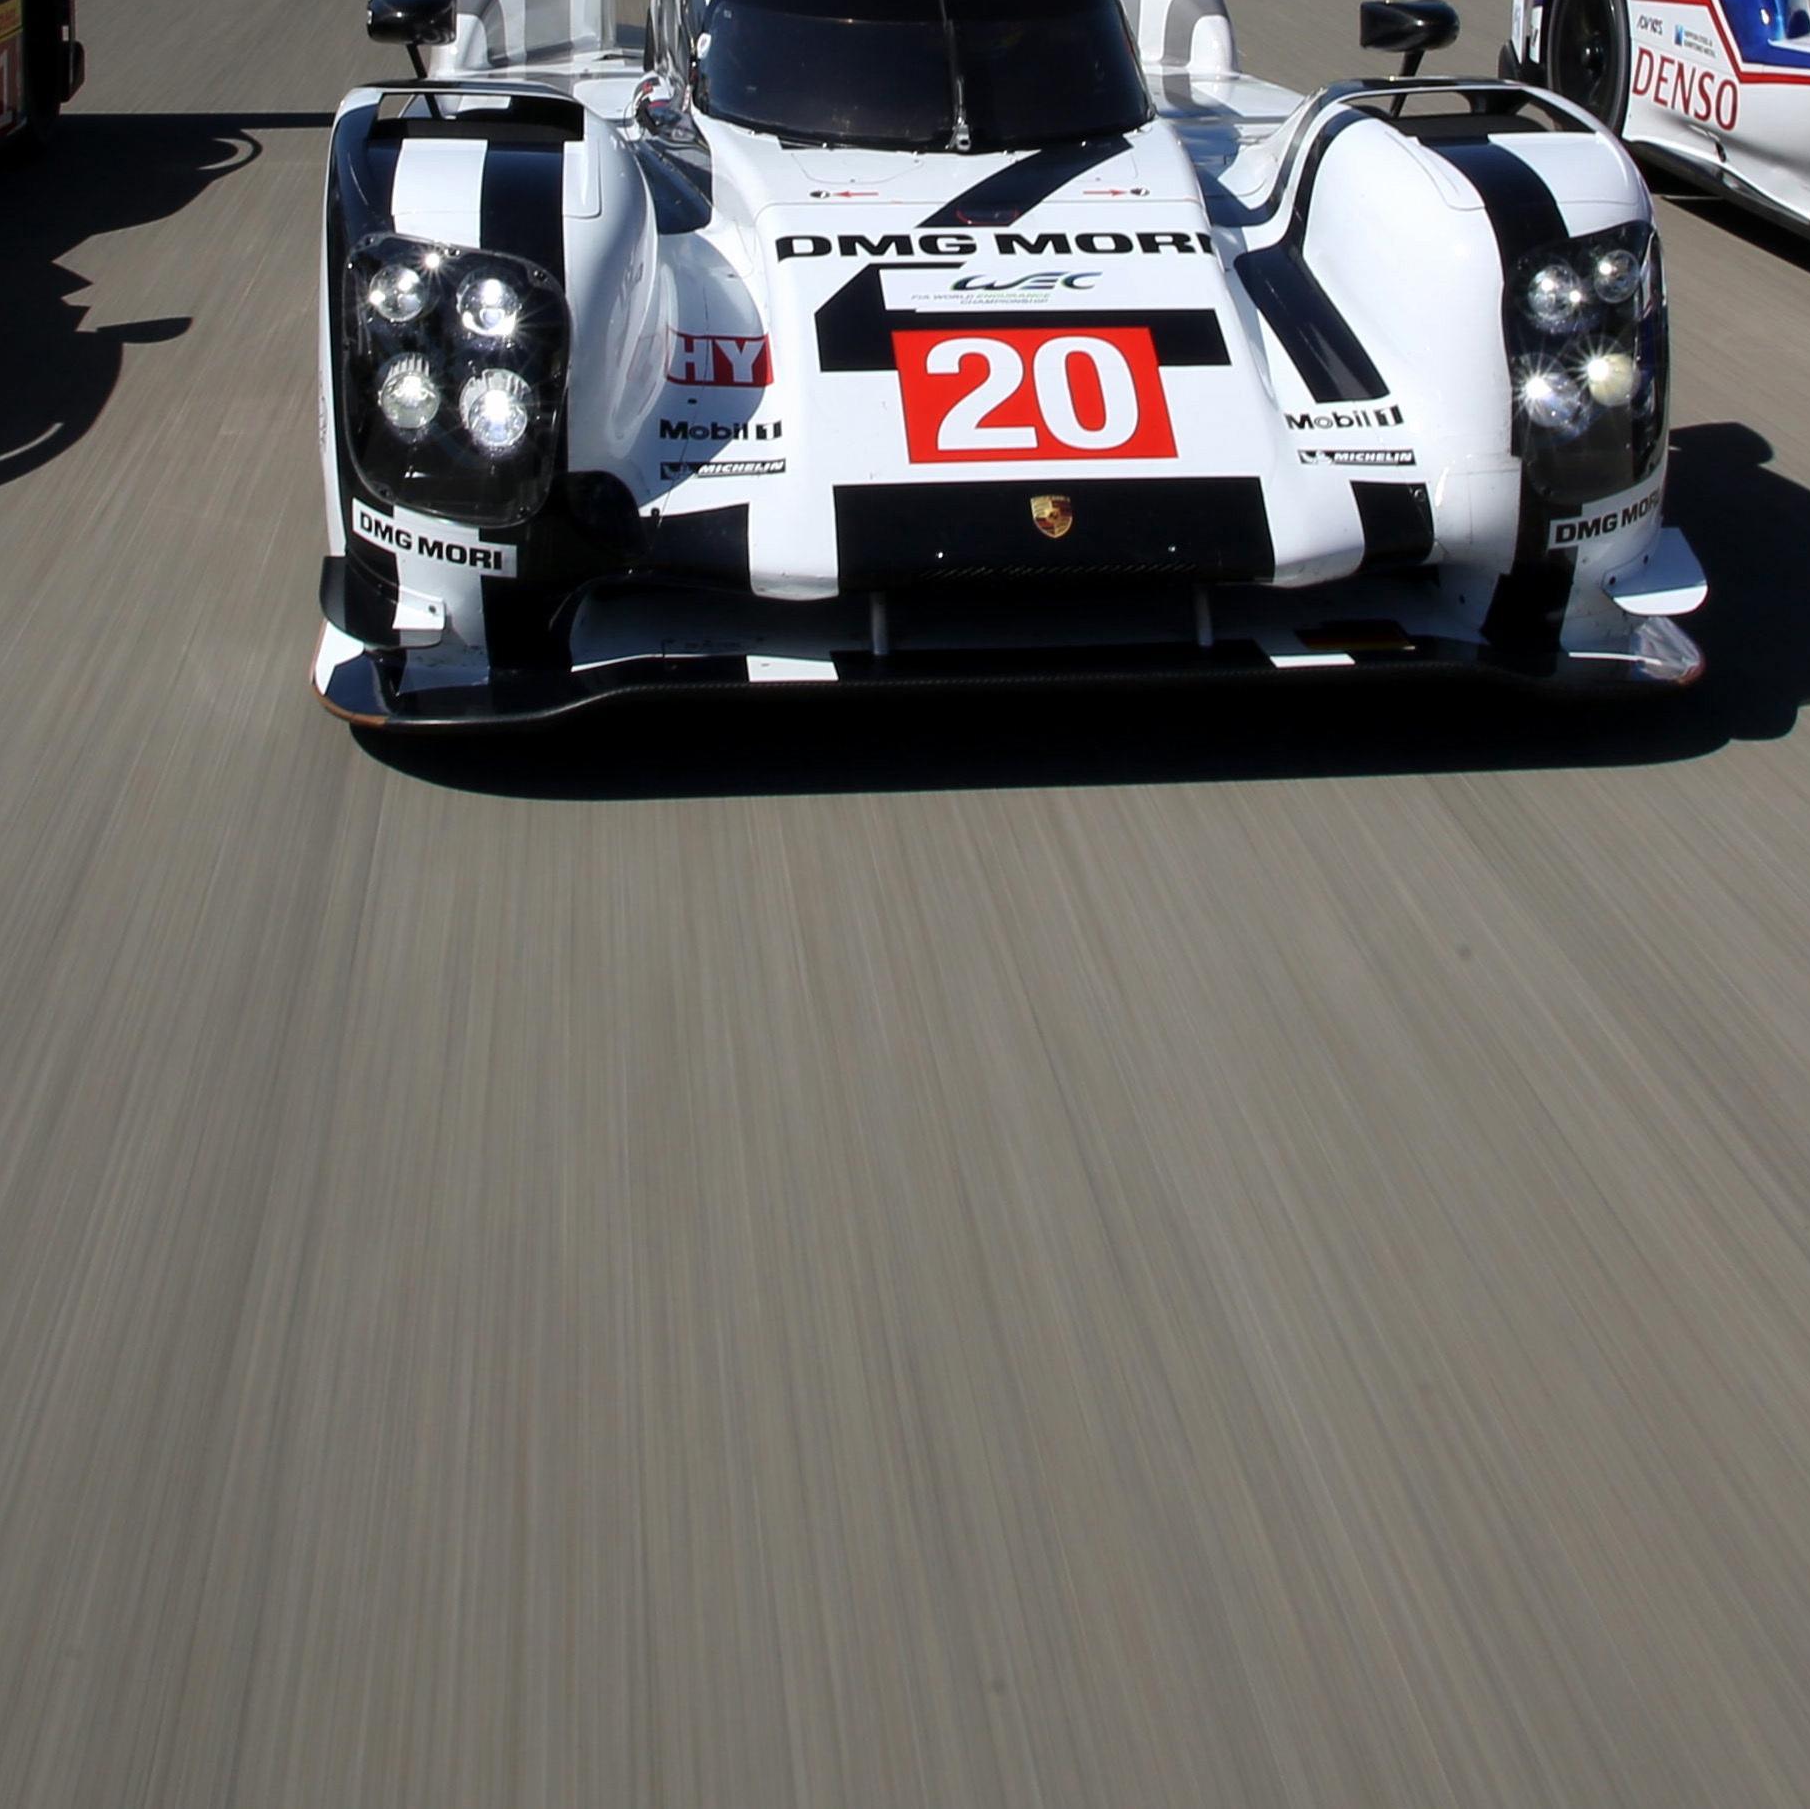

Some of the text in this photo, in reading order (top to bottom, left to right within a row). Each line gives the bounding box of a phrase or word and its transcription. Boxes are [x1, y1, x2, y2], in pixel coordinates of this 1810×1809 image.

[1632, 47, 1738, 132] DENSO
[777, 232, 1215, 262] DMG MORI
[671, 336, 766, 383] HY
[926, 337, 1139, 451] 20
[660, 420, 748, 440] Mobil
[1284, 411, 1372, 430] Mobil
[698, 461, 784, 476] MICHELIN
[1334, 452, 1412, 463] MICHELIN
[1555, 487, 1660, 543] DMG MOR
[360, 512, 503, 569] DMG MORI
